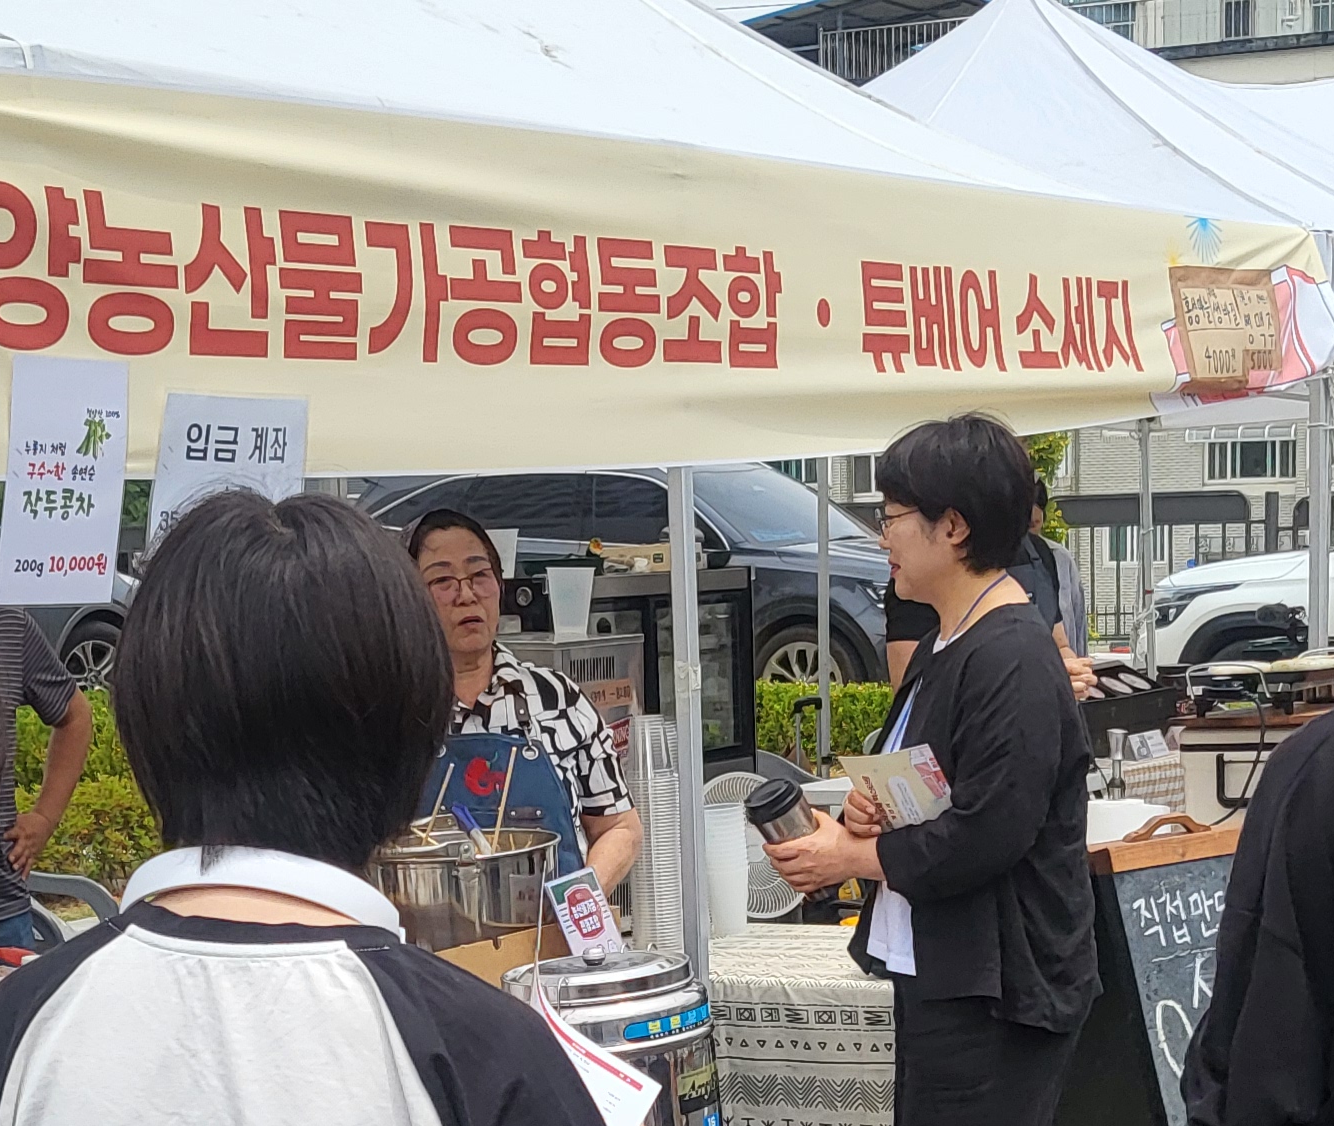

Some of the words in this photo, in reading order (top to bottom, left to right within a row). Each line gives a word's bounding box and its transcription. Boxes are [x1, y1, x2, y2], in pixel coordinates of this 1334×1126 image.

[860, 259, 1008, 374] 투베어
[1015, 271, 1145, 374] 소세지
[25, 440, 46, 455] 누룽지
[50, 442, 66, 456] 처럼
[186, 423, 239, 462] 입금
[249, 427, 287, 463] 계좌
[27, 462, 66, 480] 구수~한
[72, 465, 95, 481] 송연순
[23, 488, 95, 520] 작두콩차
[14, 559, 44, 577] 200g
[49, 553, 107, 576] 10,000원
[1132, 890, 1225, 946] 직접만
